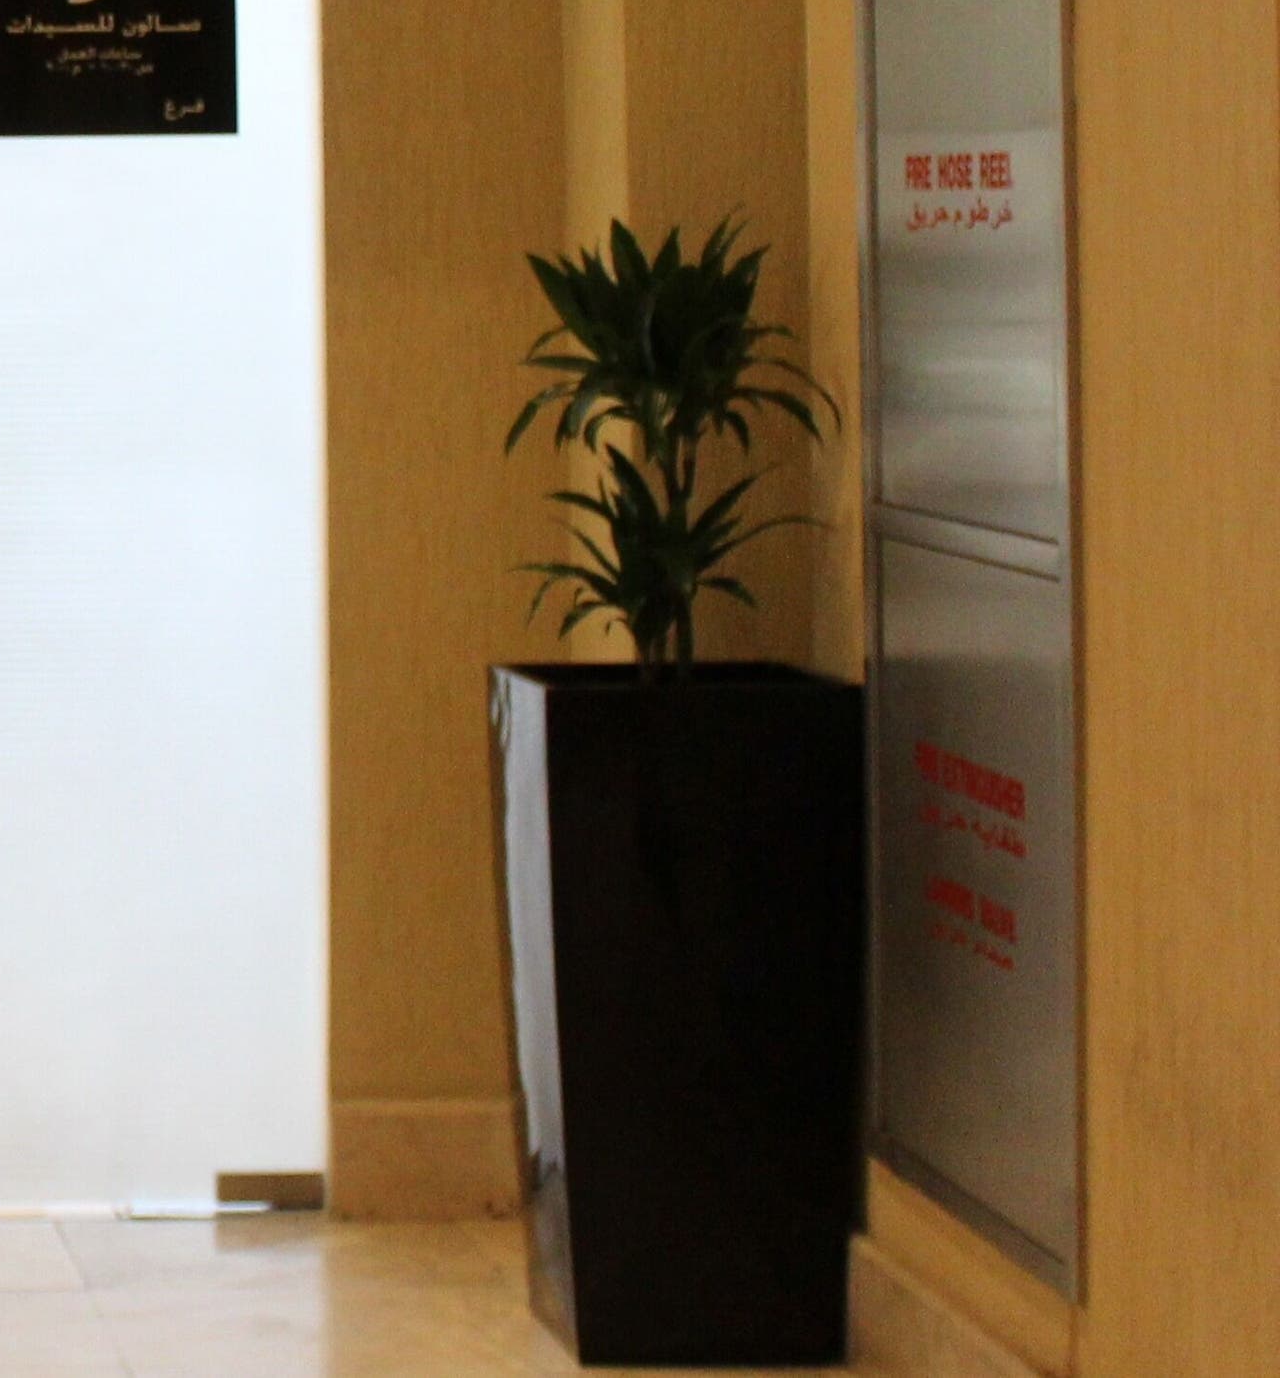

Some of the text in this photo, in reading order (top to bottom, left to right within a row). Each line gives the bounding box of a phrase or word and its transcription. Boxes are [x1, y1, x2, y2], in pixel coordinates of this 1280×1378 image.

[5, 13, 202, 39] صالون للسيدات
[937, 153, 973, 190] HOSE
[979, 151, 1014, 190] REEL
